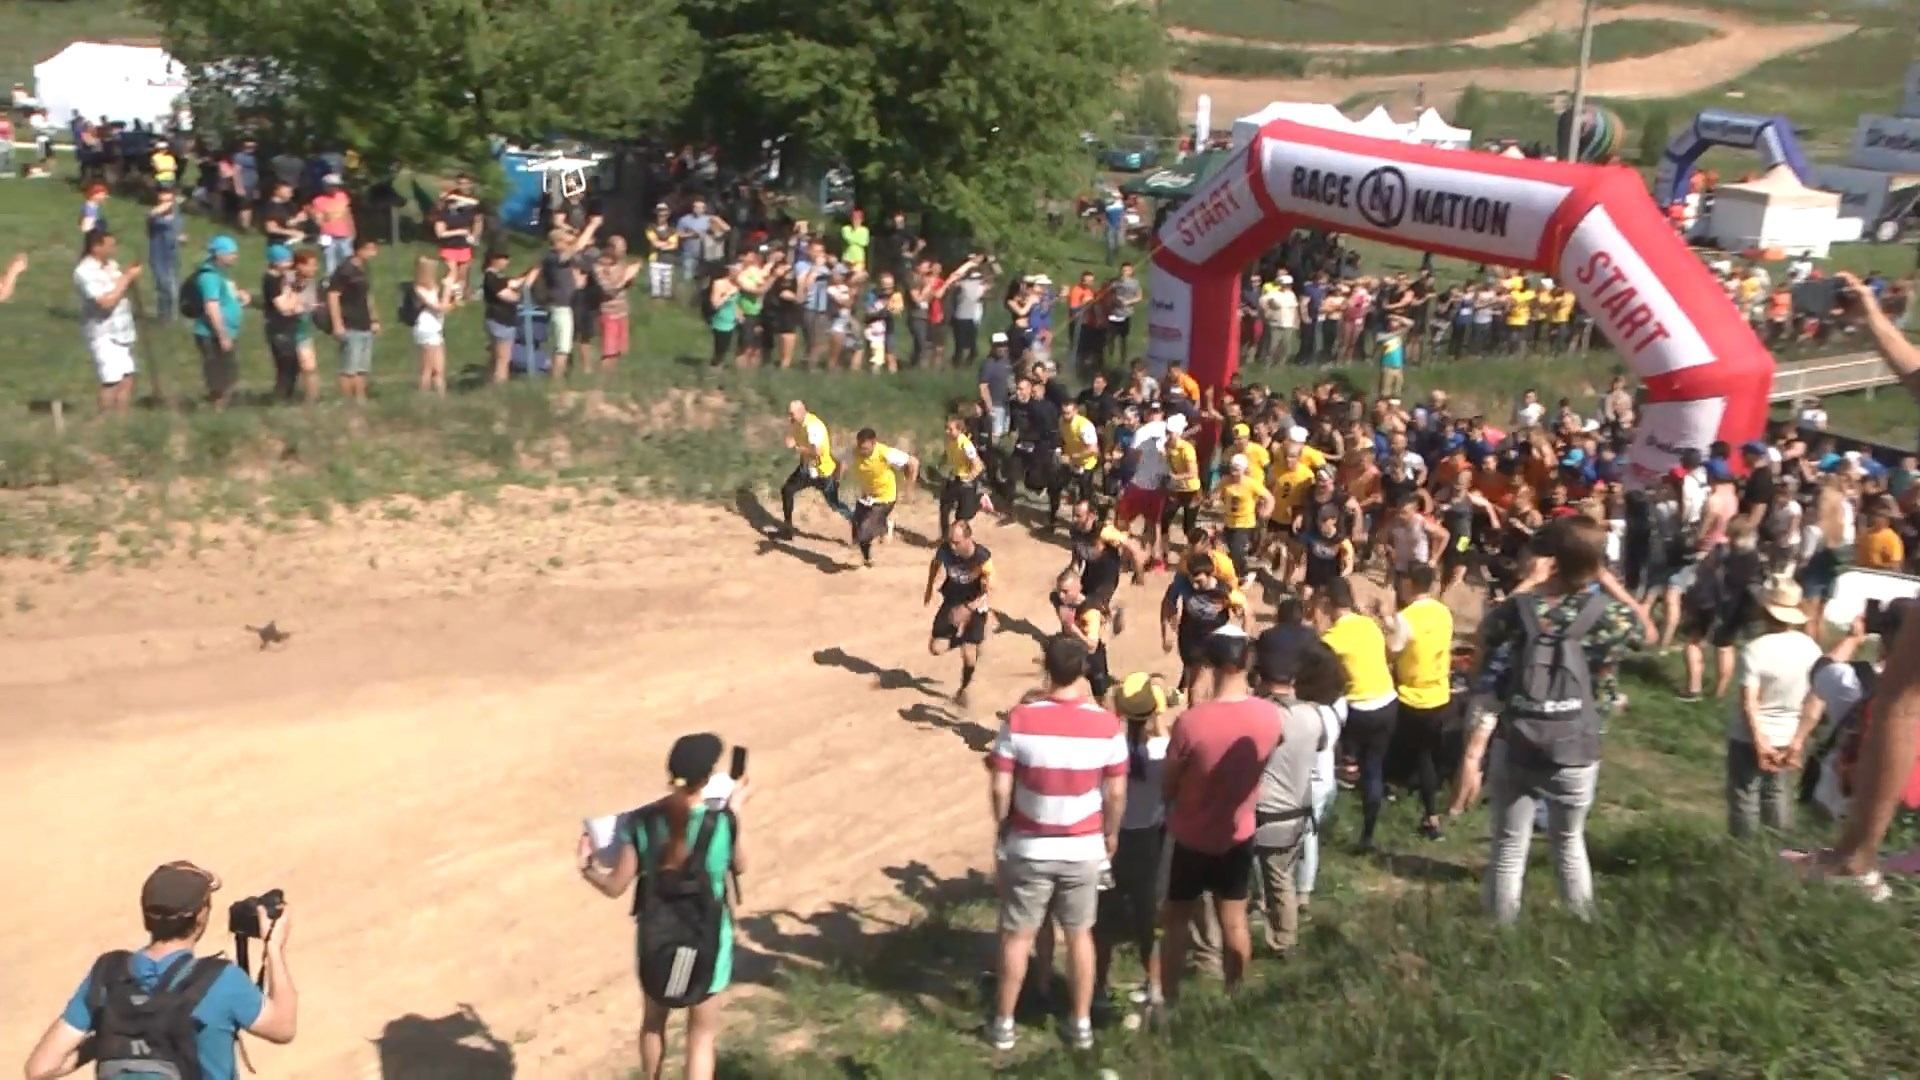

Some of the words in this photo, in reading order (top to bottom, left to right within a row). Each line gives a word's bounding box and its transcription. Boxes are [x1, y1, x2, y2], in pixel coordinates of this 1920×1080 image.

[1176, 180, 1240, 247] START
[1291, 165, 1353, 208] RACE
[1412, 188, 1512, 237] NATION
[1576, 250, 1671, 354] START
